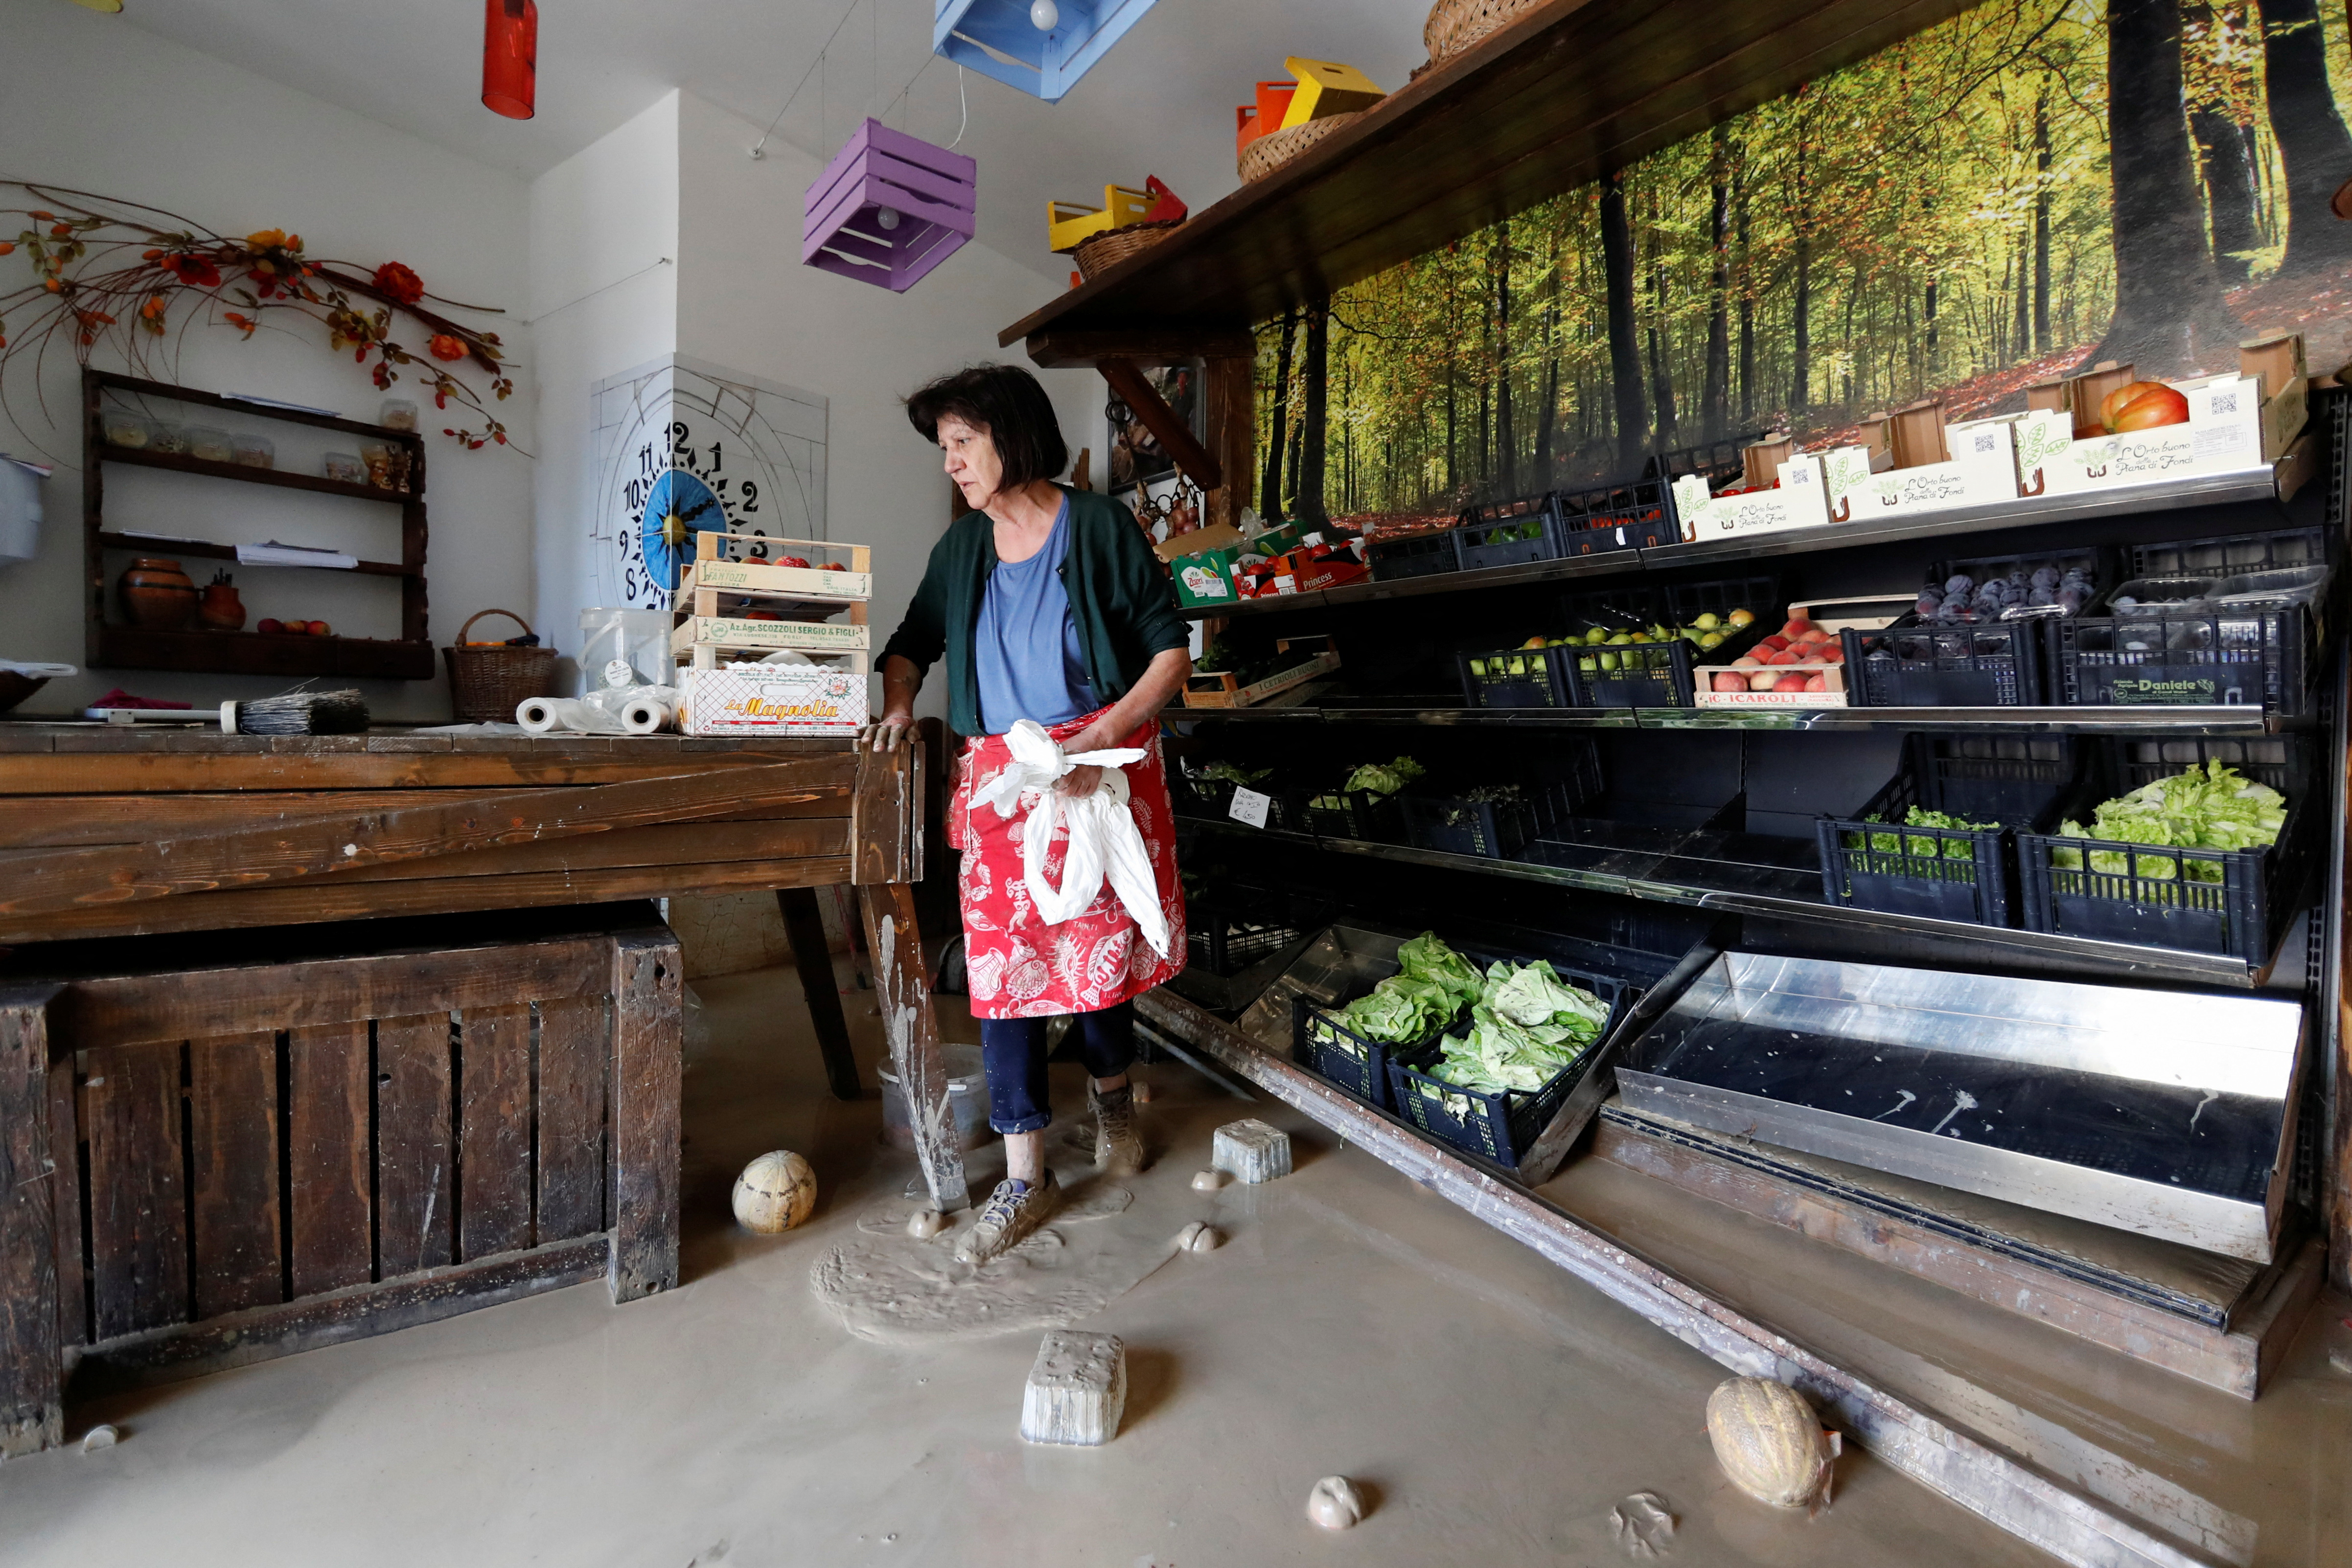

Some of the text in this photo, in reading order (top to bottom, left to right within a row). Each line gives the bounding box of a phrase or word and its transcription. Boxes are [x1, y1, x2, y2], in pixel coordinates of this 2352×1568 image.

[664, 422, 690, 454] 12
[2161, 441, 2190, 452] buono
[638, 442, 653, 475] 11
[708, 441, 722, 472] 1
[2115, 454, 2193, 476] Piana di Fondi
[1939, 474, 1961, 484] buono
[623, 479, 640, 512] 10
[741, 481, 759, 512] 2
[1904, 492, 1928, 503] Piana
[1938, 486, 1964, 499] Fondi
[1766, 502, 1783, 511] buono
[1738, 518, 1758, 528] Piana
[1765, 513, 1786, 524] Fondi
[619, 530, 628, 562] 9
[750, 529, 769, 559] 3
[625, 568, 637, 601] 8
[709, 572, 747, 583] FANTOZZI
[1188, 577, 1204, 587] Zespri
[1303, 572, 1332, 590] Princess
[758, 624, 796, 633] SCOZZOLI
[798, 626, 826, 635] SERGIO
[1264, 669, 1297, 689] CETRIOLI
[1298, 662, 1319, 676] BUONI
[2139, 679, 2196, 691] Daniele
[724, 697, 839, 720] La Magnolia
[1234, 808, 1241, 816] €
